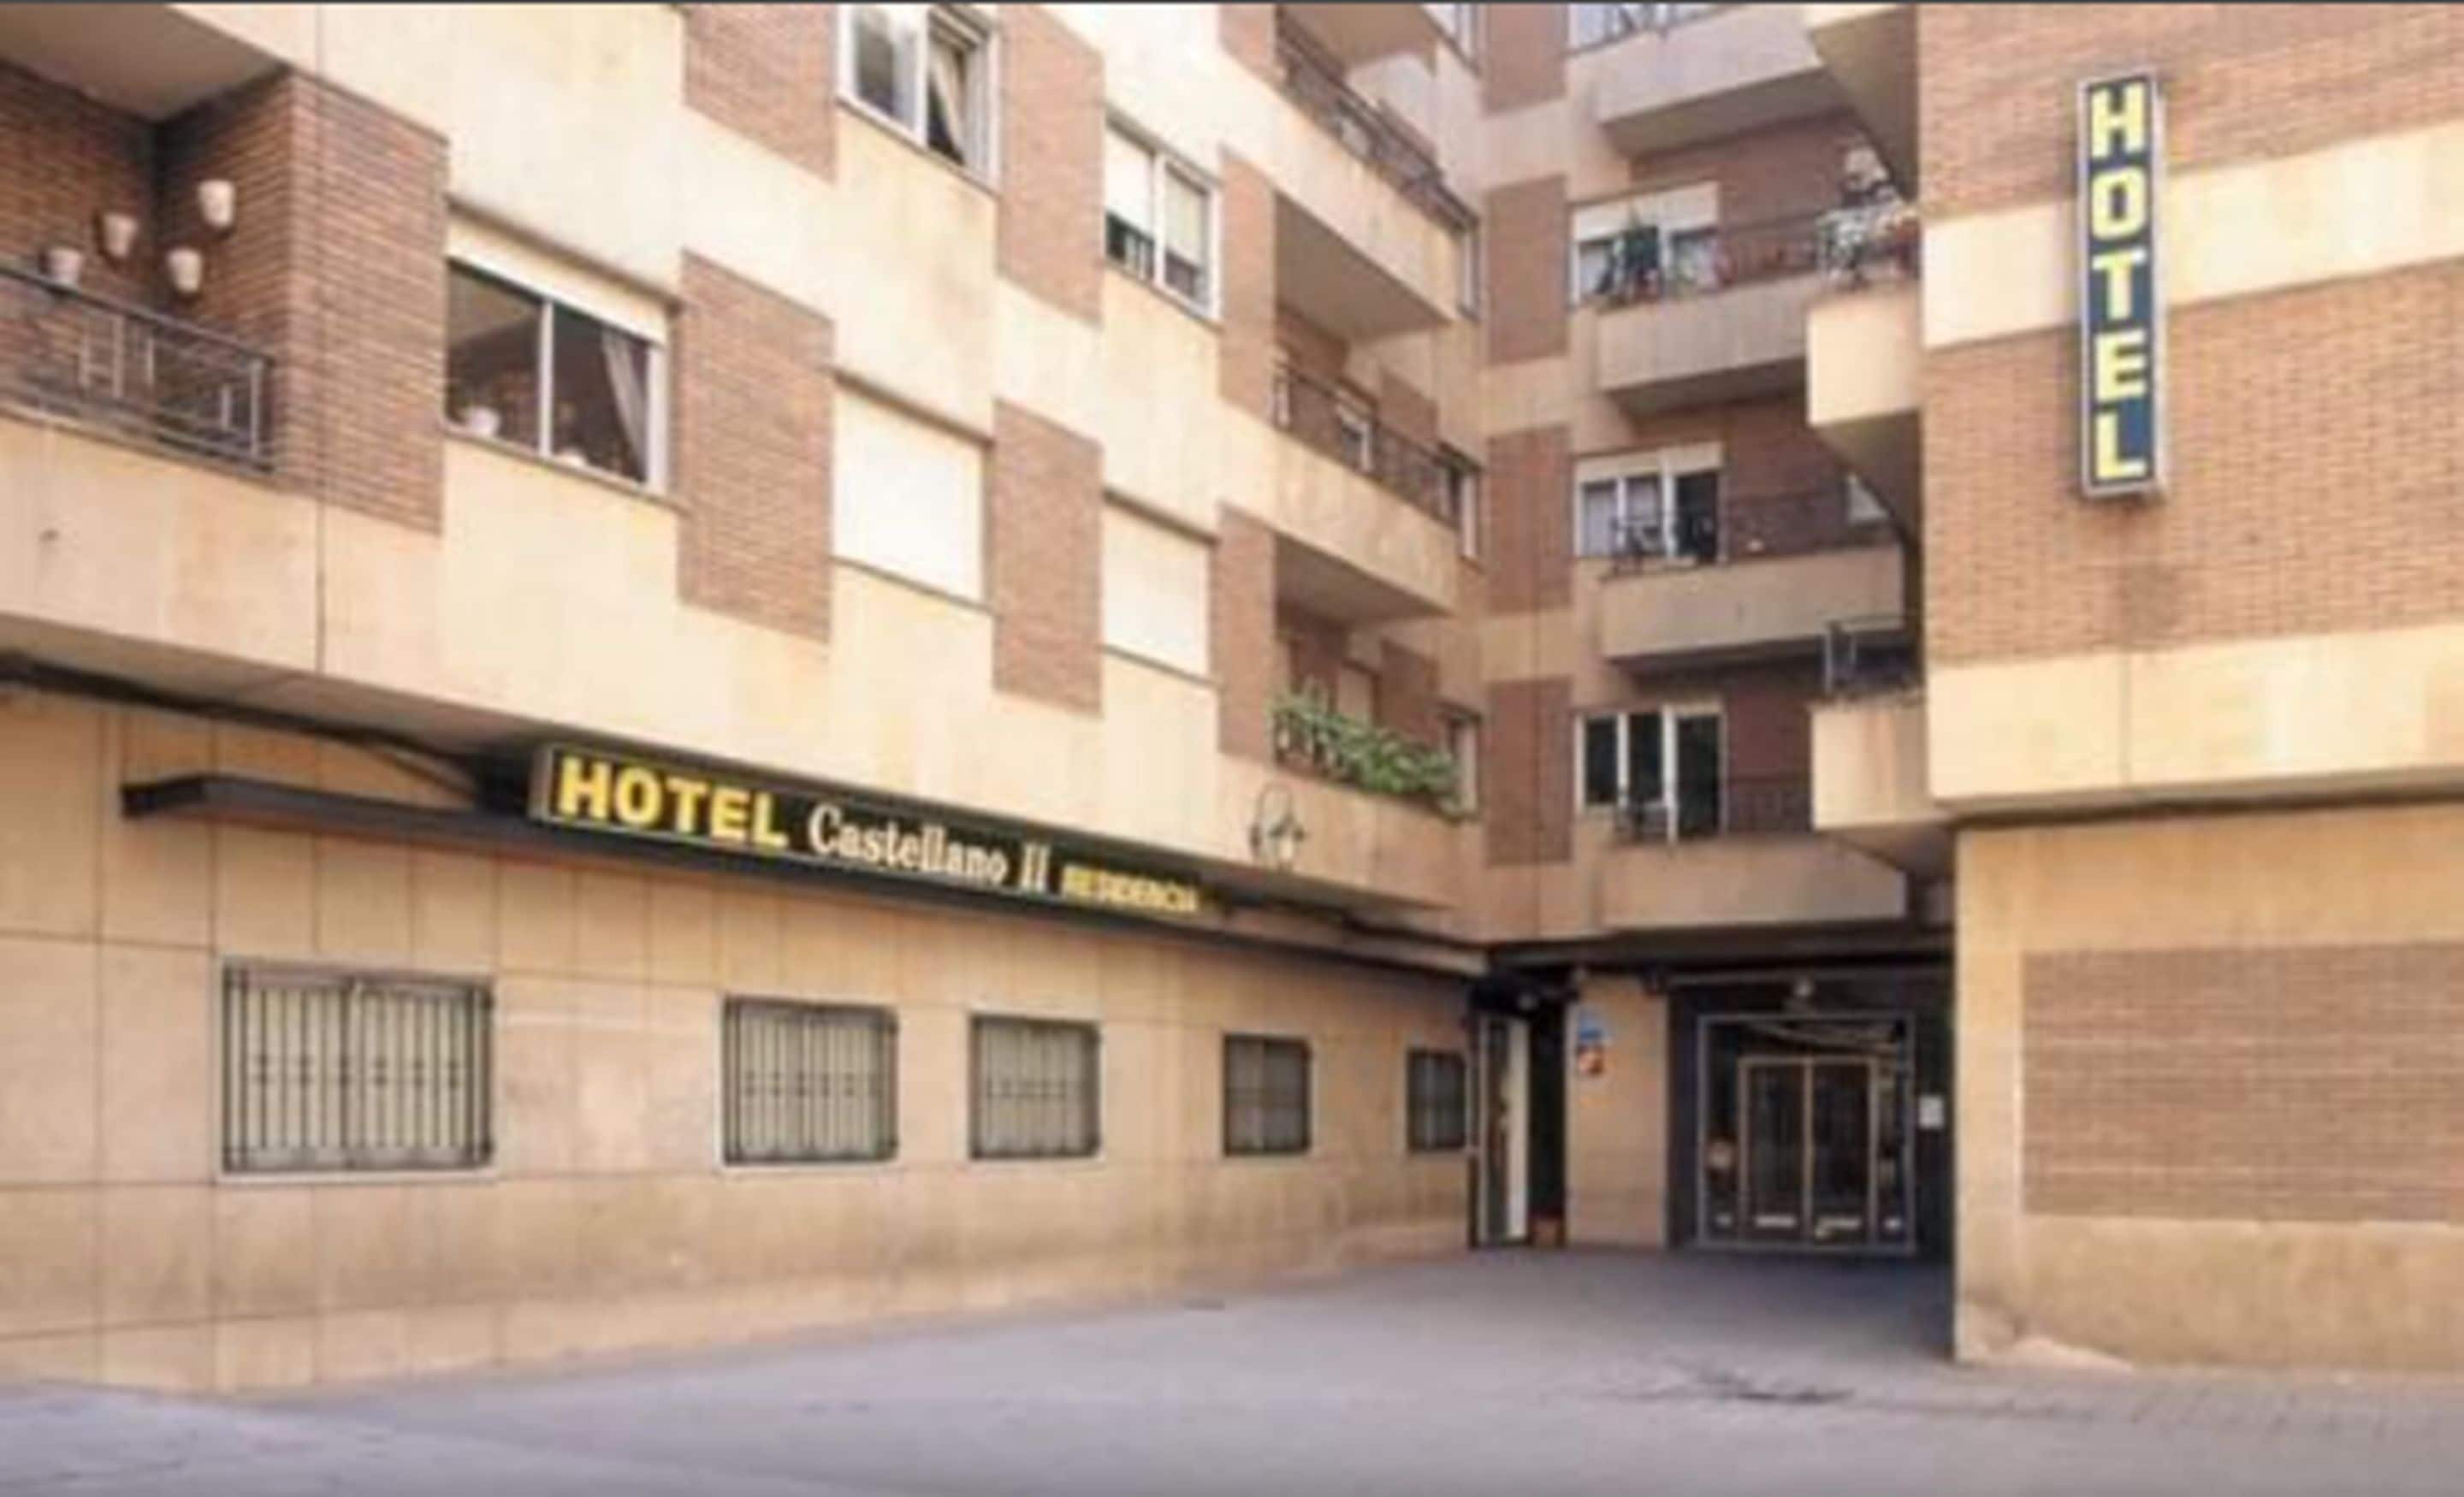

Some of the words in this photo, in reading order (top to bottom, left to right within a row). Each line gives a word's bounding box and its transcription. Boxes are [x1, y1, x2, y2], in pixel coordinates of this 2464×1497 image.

[2090, 83, 2147, 481] HOTEL
[559, 755, 790, 849] HOTEL
[808, 802, 1009, 885] Castellano
